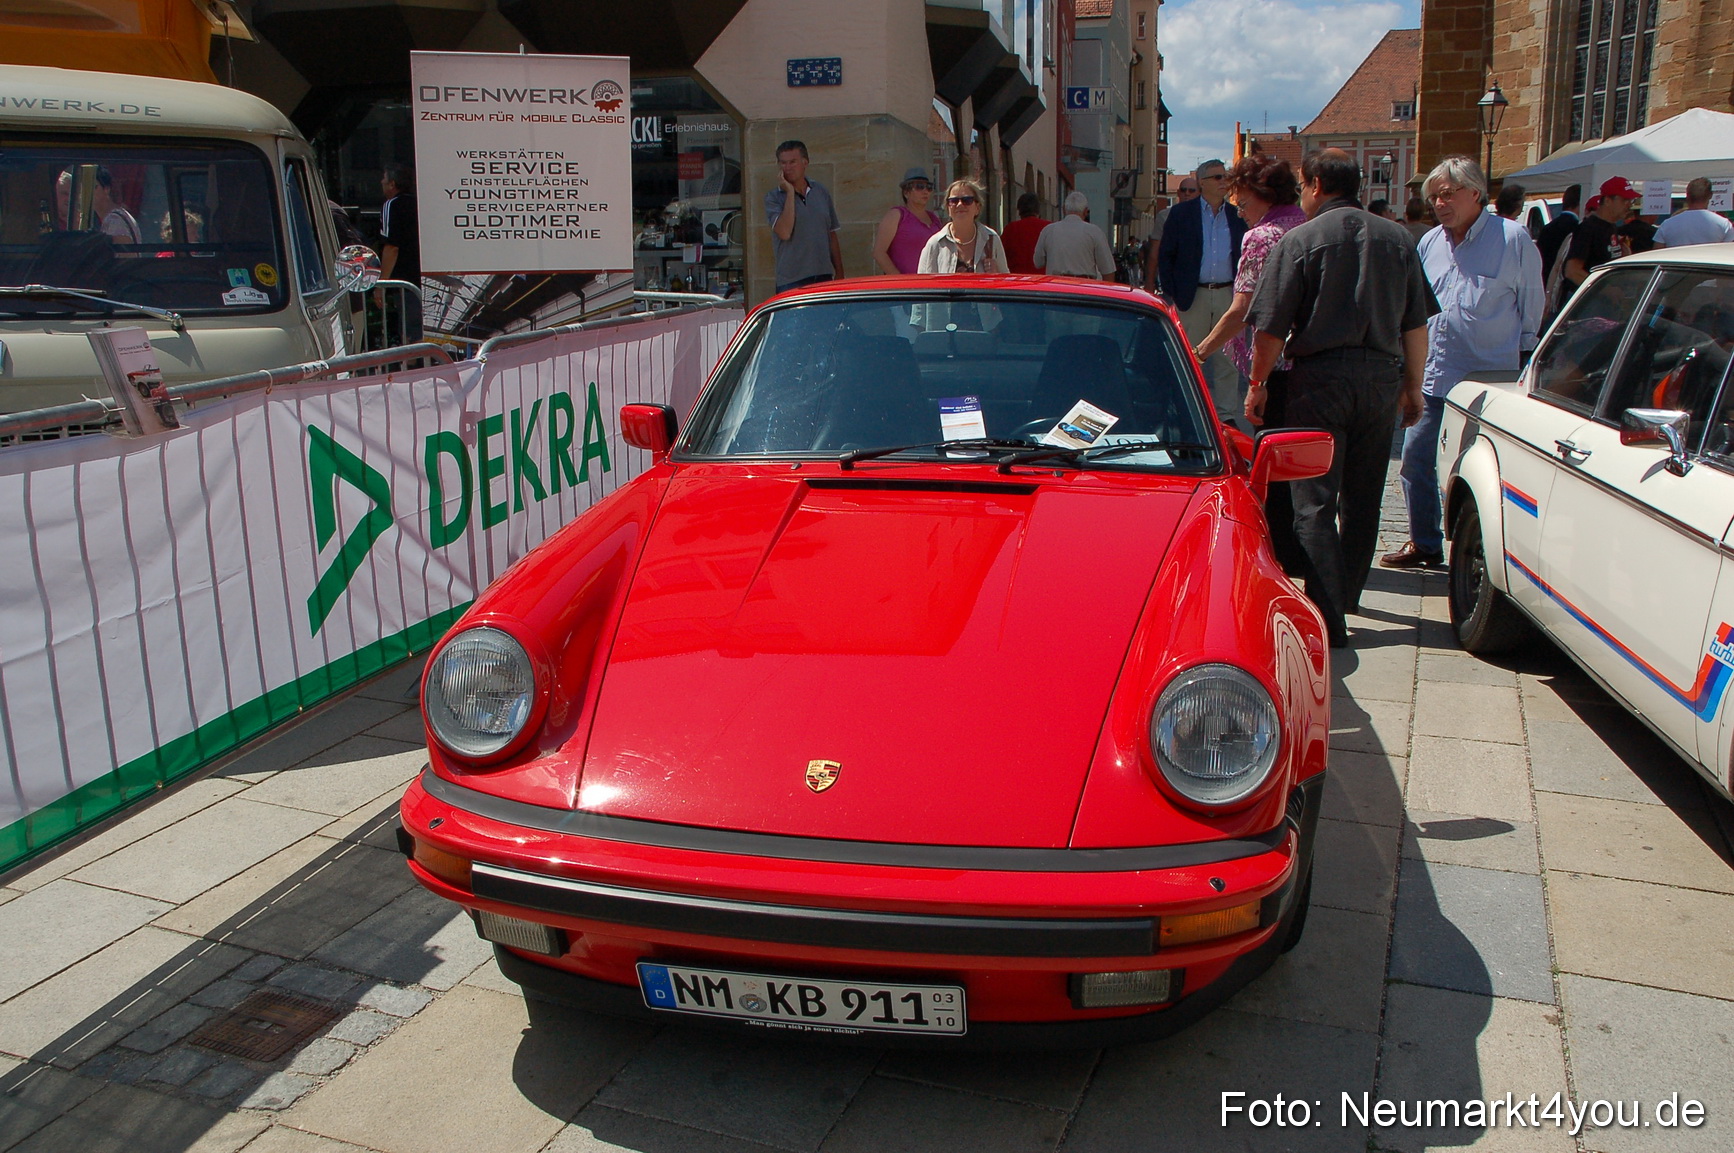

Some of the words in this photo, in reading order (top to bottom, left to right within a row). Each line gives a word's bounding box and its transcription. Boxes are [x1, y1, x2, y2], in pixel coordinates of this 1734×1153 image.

[420, 85, 589, 106] OFENWERK
[1094, 90, 1105, 106] M
[489, 111, 514, 122] FÜR
[520, 114, 568, 122] MOBILE
[631, 116, 662, 142] CKL
[665, 122, 732, 133] Erlebnishaus.
[456, 148, 564, 159] WERKSTÄTTEN
[471, 161, 579, 175] SERVICE
[460, 176, 588, 186] EINSTELLFLÄCHEN
[444, 189, 579, 200] YOUNGTIMER
[466, 203, 608, 211] SERVICEPARTNER
[453, 214, 580, 227] OLDTIMER
[463, 229, 601, 240] GASTRONOMIE
[425, 381, 611, 550] DEKRA
[1709, 636, 1734, 666] turb
[655, 989, 666, 999] D
[672, 972, 734, 1010] NM
[765, 981, 827, 1018] KB
[840, 987, 929, 1026] 911
[932, 992, 954, 1003] 03
[935, 1016, 955, 1027] 10
